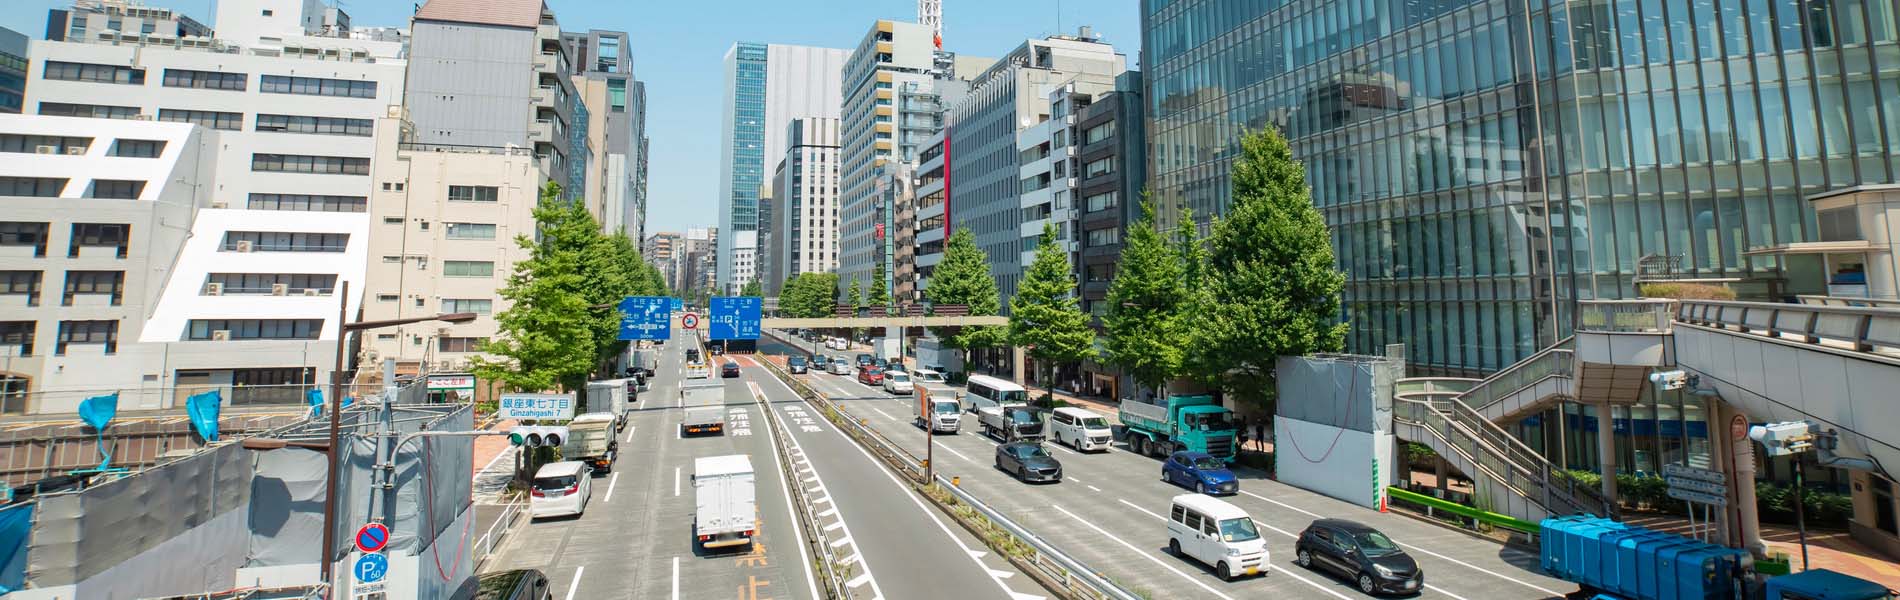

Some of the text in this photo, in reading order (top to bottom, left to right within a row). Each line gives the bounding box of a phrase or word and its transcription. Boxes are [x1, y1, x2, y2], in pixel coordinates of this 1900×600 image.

[502, 398, 569, 409] 銀座東七丁目
[362, 561, 380, 580] P 60
